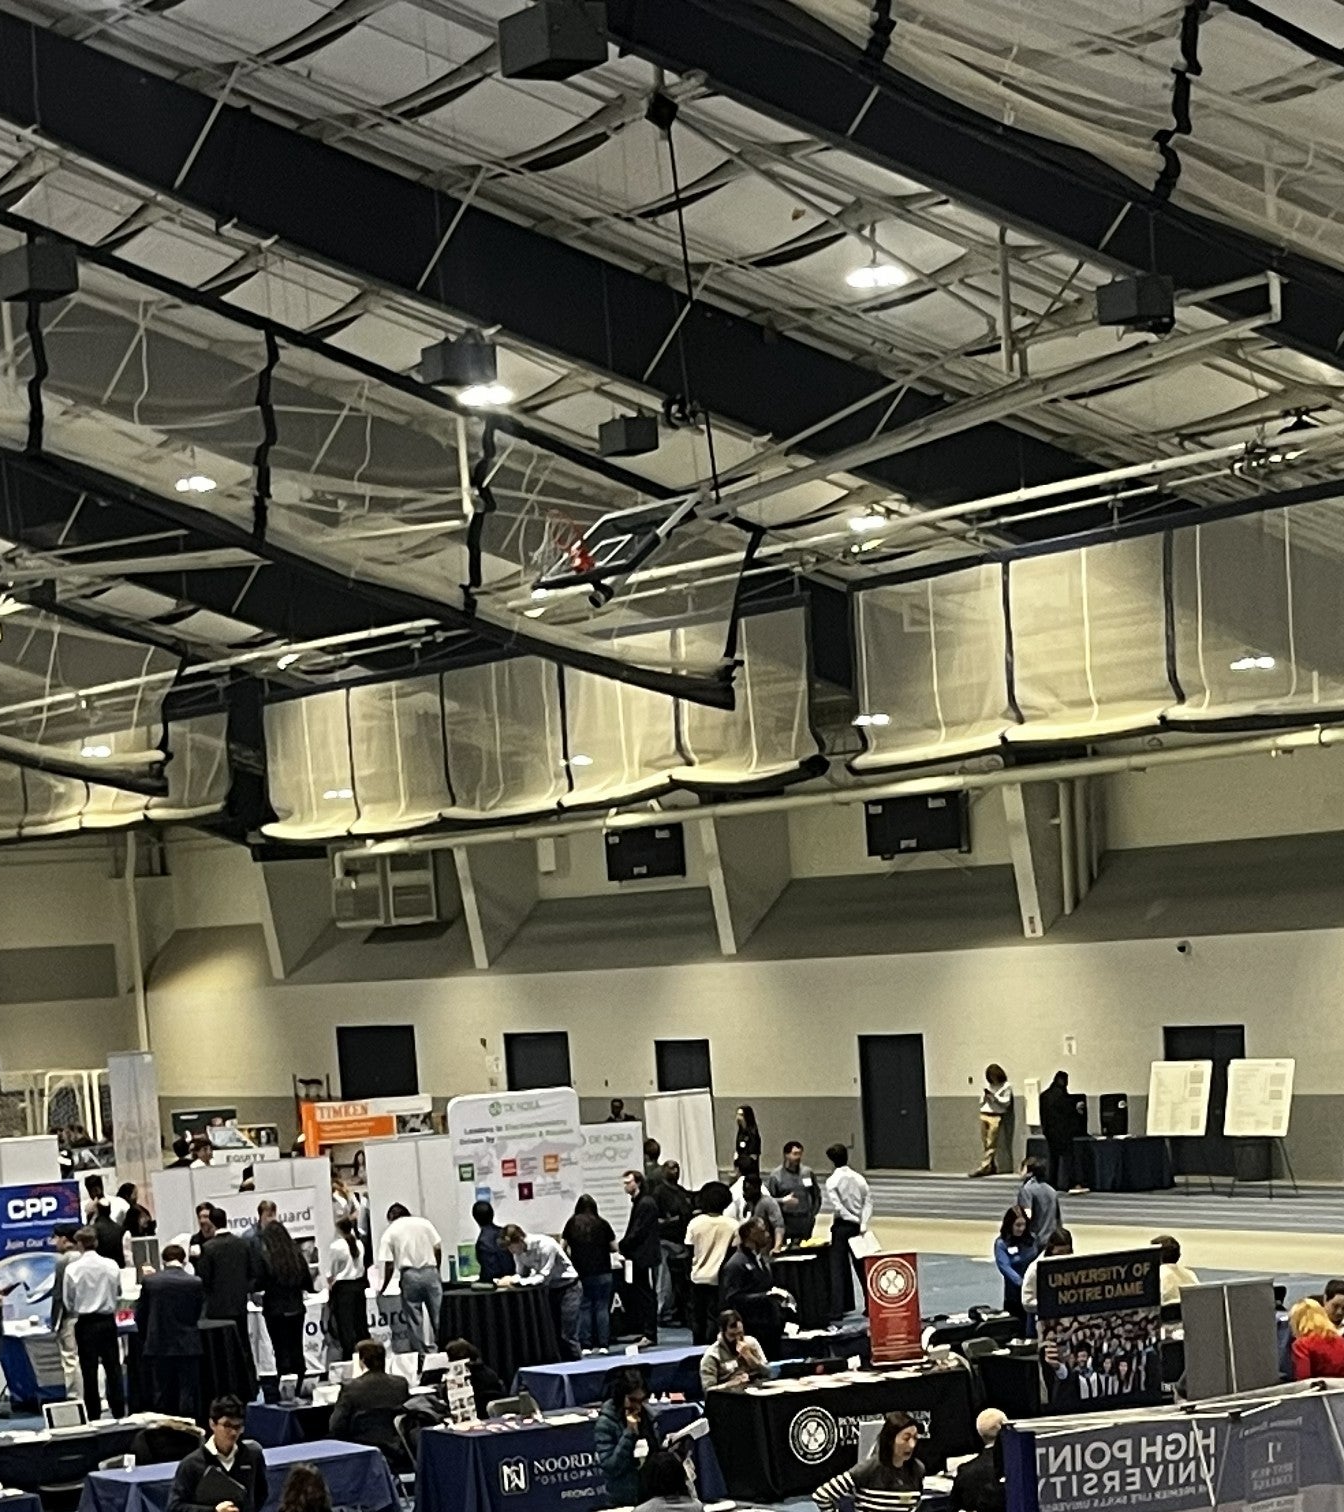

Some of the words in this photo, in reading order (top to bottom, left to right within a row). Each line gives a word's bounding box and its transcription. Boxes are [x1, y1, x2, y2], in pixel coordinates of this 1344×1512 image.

[318, 1103, 369, 1119] TIMKEN
[7, 1196, 58, 1220] CPP
[1048, 1265, 1128, 1288] UNIVERSITY
[1132, 1262, 1151, 1278] OF
[1058, 1286, 1102, 1304] NOTRE
[1105, 1281, 1144, 1298] DAME
